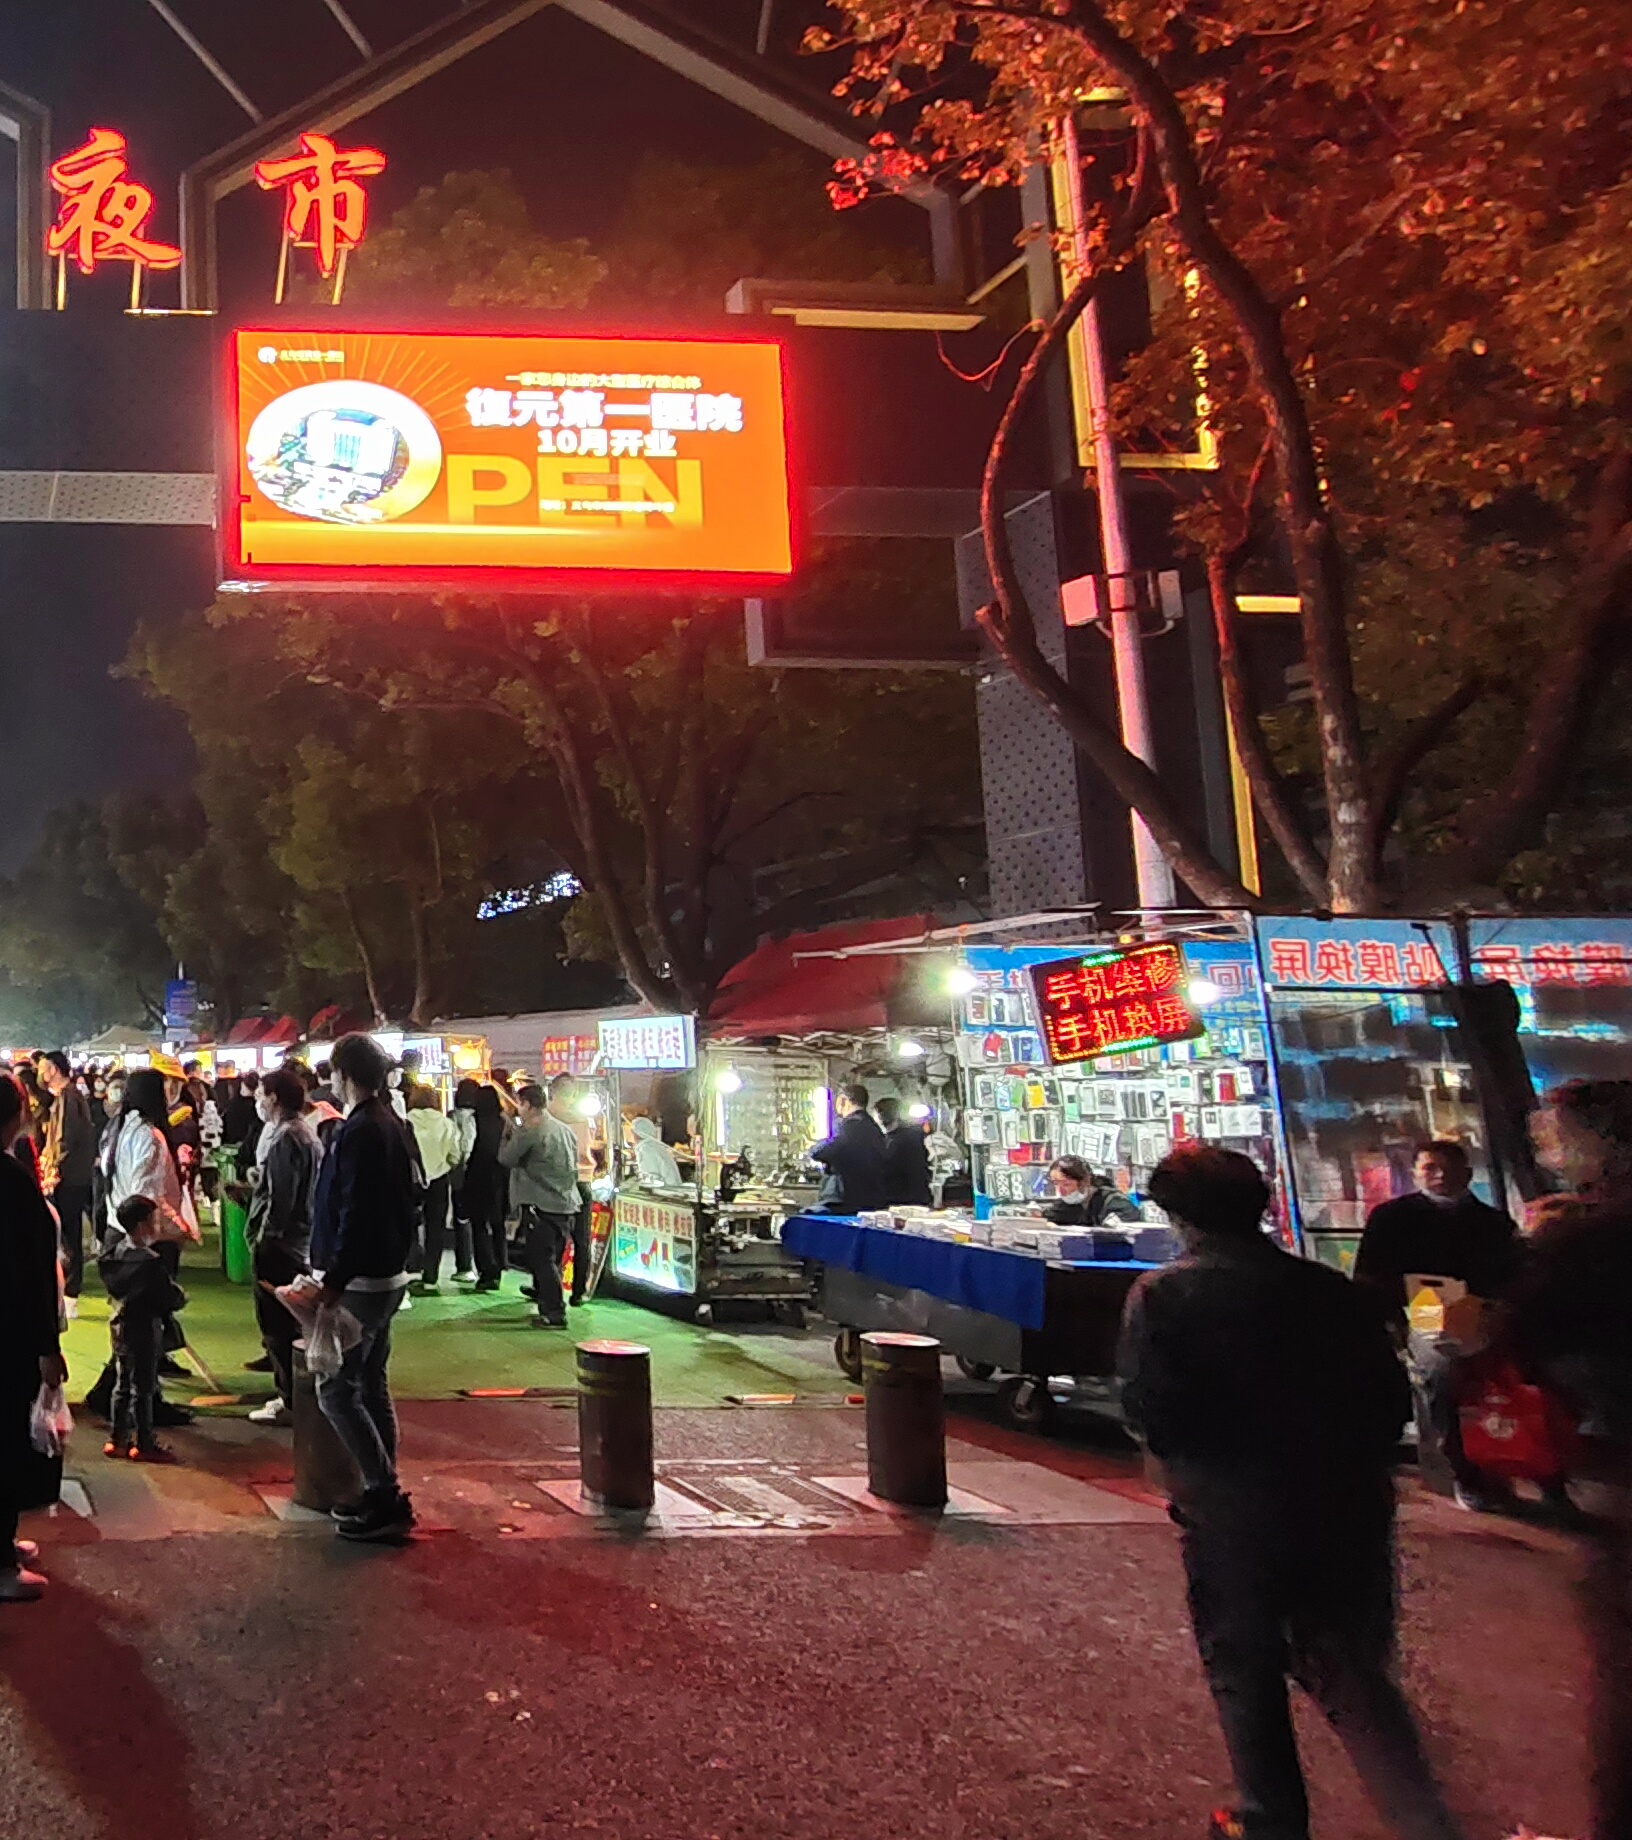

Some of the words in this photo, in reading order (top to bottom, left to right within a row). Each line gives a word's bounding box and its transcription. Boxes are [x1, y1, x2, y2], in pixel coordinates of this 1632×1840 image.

[537, 428, 678, 457] 10月开业
[1047, 951, 1179, 1011] 手机维修
[1056, 995, 1192, 1051] 手机换屏
